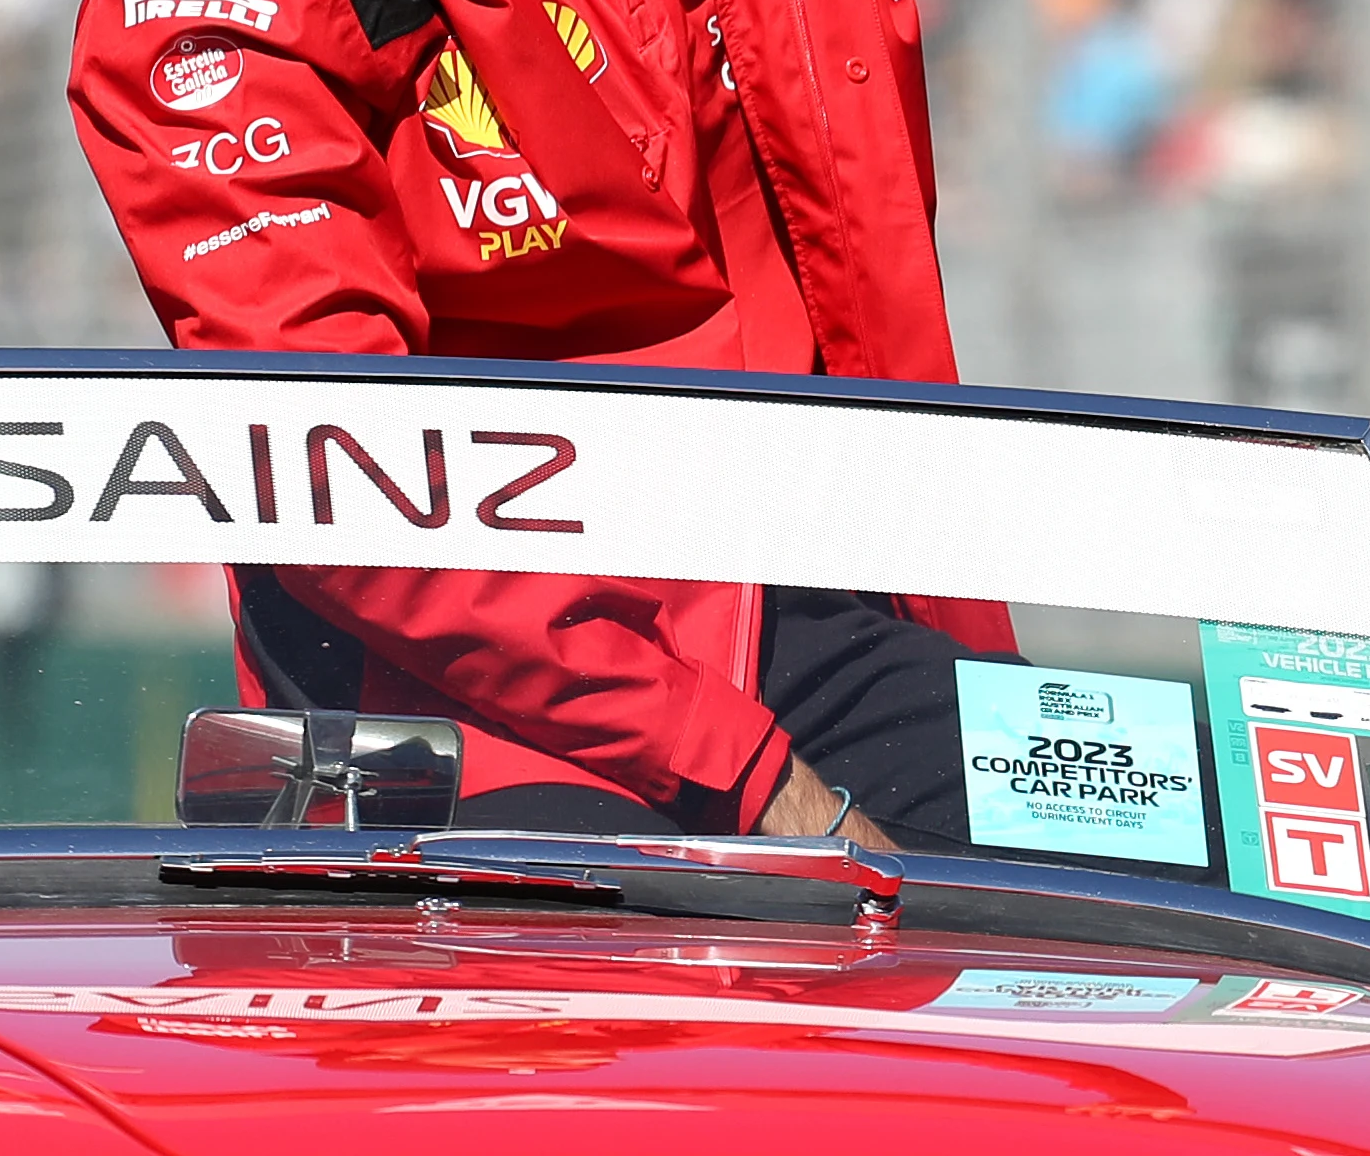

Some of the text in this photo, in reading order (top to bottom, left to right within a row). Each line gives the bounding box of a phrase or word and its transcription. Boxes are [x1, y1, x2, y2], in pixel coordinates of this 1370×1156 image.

[163, 48, 226, 81] Estrella
[171, 65, 228, 96] Galicia
[478, 220, 568, 260] PLAY
[1261, 652, 1362, 678] VEHICLE
[1027, 736, 1134, 767] 2023
[972, 756, 1192, 791] COMPETITORS'
[1267, 750, 1345, 788] SV
[1010, 778, 1160, 807] CAR PARK
[1026, 801, 1147, 820] NO ACCESS TO CIRCUIT
[1031, 811, 1144, 829] DURING EVENT DAYS
[1286, 829, 1345, 876] T
